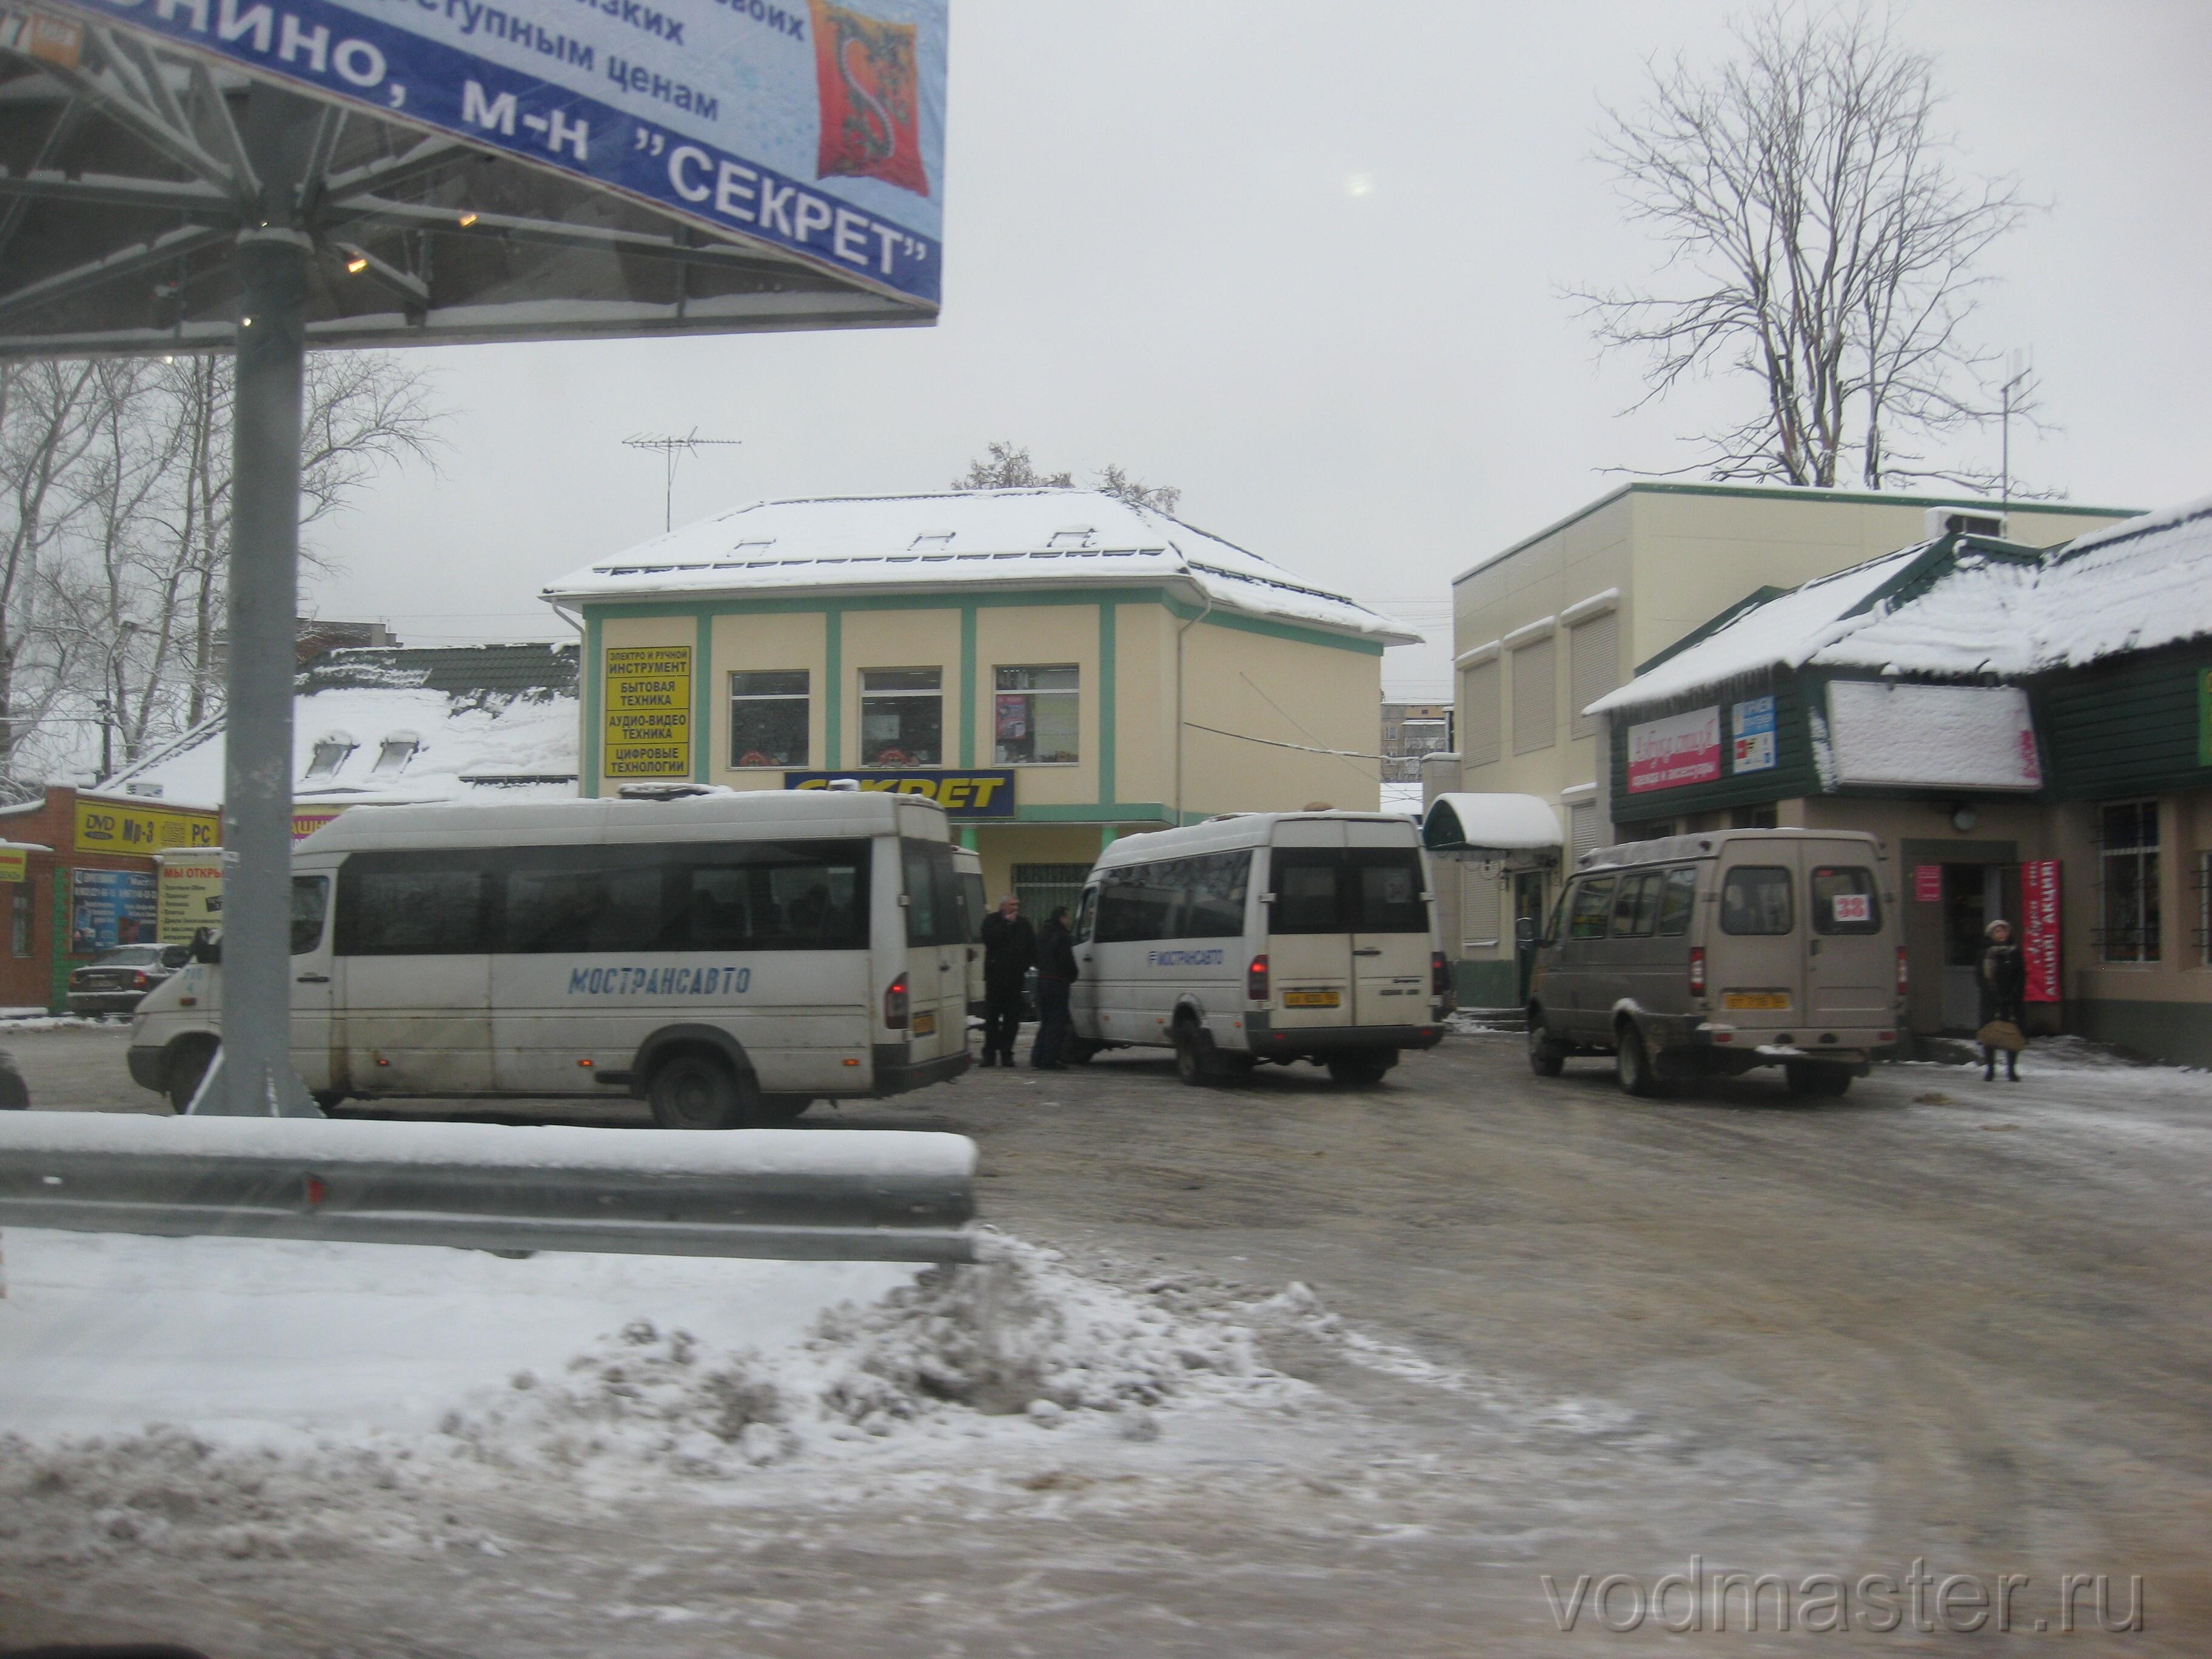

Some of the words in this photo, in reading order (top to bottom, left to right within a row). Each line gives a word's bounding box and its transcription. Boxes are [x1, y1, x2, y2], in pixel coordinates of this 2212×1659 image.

[709, 0, 804, 42] воих
[608, 55, 719, 121] ценам
[611, 652, 645, 660] ЭЛЕКТРО
[648, 651, 653, 660] И
[655, 649, 687, 659] РУЧНОЙ
[609, 662, 686, 674] ИНСТРУМЕНТ
[621, 681, 675, 692] БЫТОВАЯ
[621, 694, 671, 706] ТЕХНИКА
[609, 715, 686, 728] АУДИО-ВИДЕО
[622, 728, 672, 739] ТЕХНИКА
[616, 748, 679, 760] ЦИФРОВЫЕ
[611, 761, 684, 773] ТЕХНОЛОГИИ
[85, 814, 115, 831] DVD
[192, 823, 210, 843] PC
[164, 868, 184, 878] МЫ
[1159, 950, 1222, 965] МОСТРАНСАВТО
[567, 967, 751, 995] МОСТРАНСАВТО
